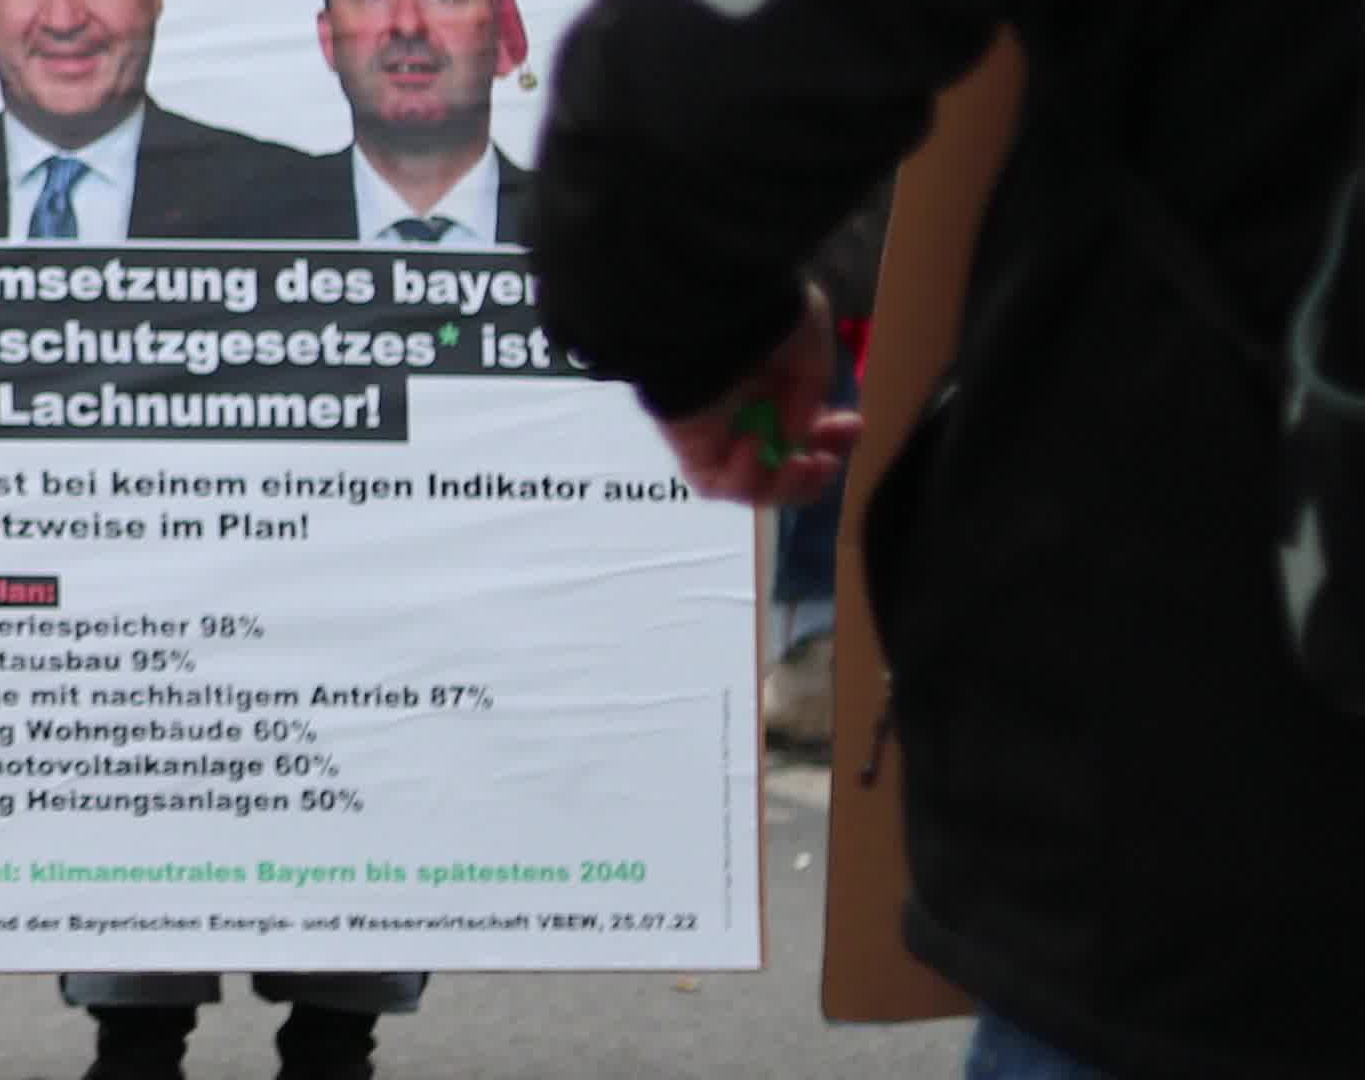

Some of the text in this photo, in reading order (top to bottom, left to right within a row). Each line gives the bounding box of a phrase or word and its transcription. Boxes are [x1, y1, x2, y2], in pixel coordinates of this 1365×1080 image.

[276, 262, 374, 302] des
[482, 327, 550, 368] ist
[42, 471, 96, 496] bei
[113, 472, 246, 496] keinem
[262, 473, 412, 504] einzigen
[429, 474, 588, 501] Indikator
[605, 477, 688, 501] auch
[162, 515, 202, 537] im
[220, 514, 307, 538] Plan!
[201, 616, 263, 638] 98%
[132, 650, 194, 672] 95%
[31, 687, 78, 706] mit
[92, 685, 299, 712] nachhaltigem
[311, 686, 418, 709] Antrieb
[431, 686, 493, 707] 87%
[27, 720, 241, 746] Wohngebäude
[254, 720, 317, 742] 60%
[275, 754, 338, 776] 60%
[28, 790, 288, 816] Heizungsanlagen
[302, 790, 362, 811] 50%
[30, 862, 248, 885] klimaneutrales
[256, 861, 357, 888] Bayern
[365, 862, 407, 882] bis
[419, 860, 570, 889] spätestens
[581, 861, 645, 884] 2040
